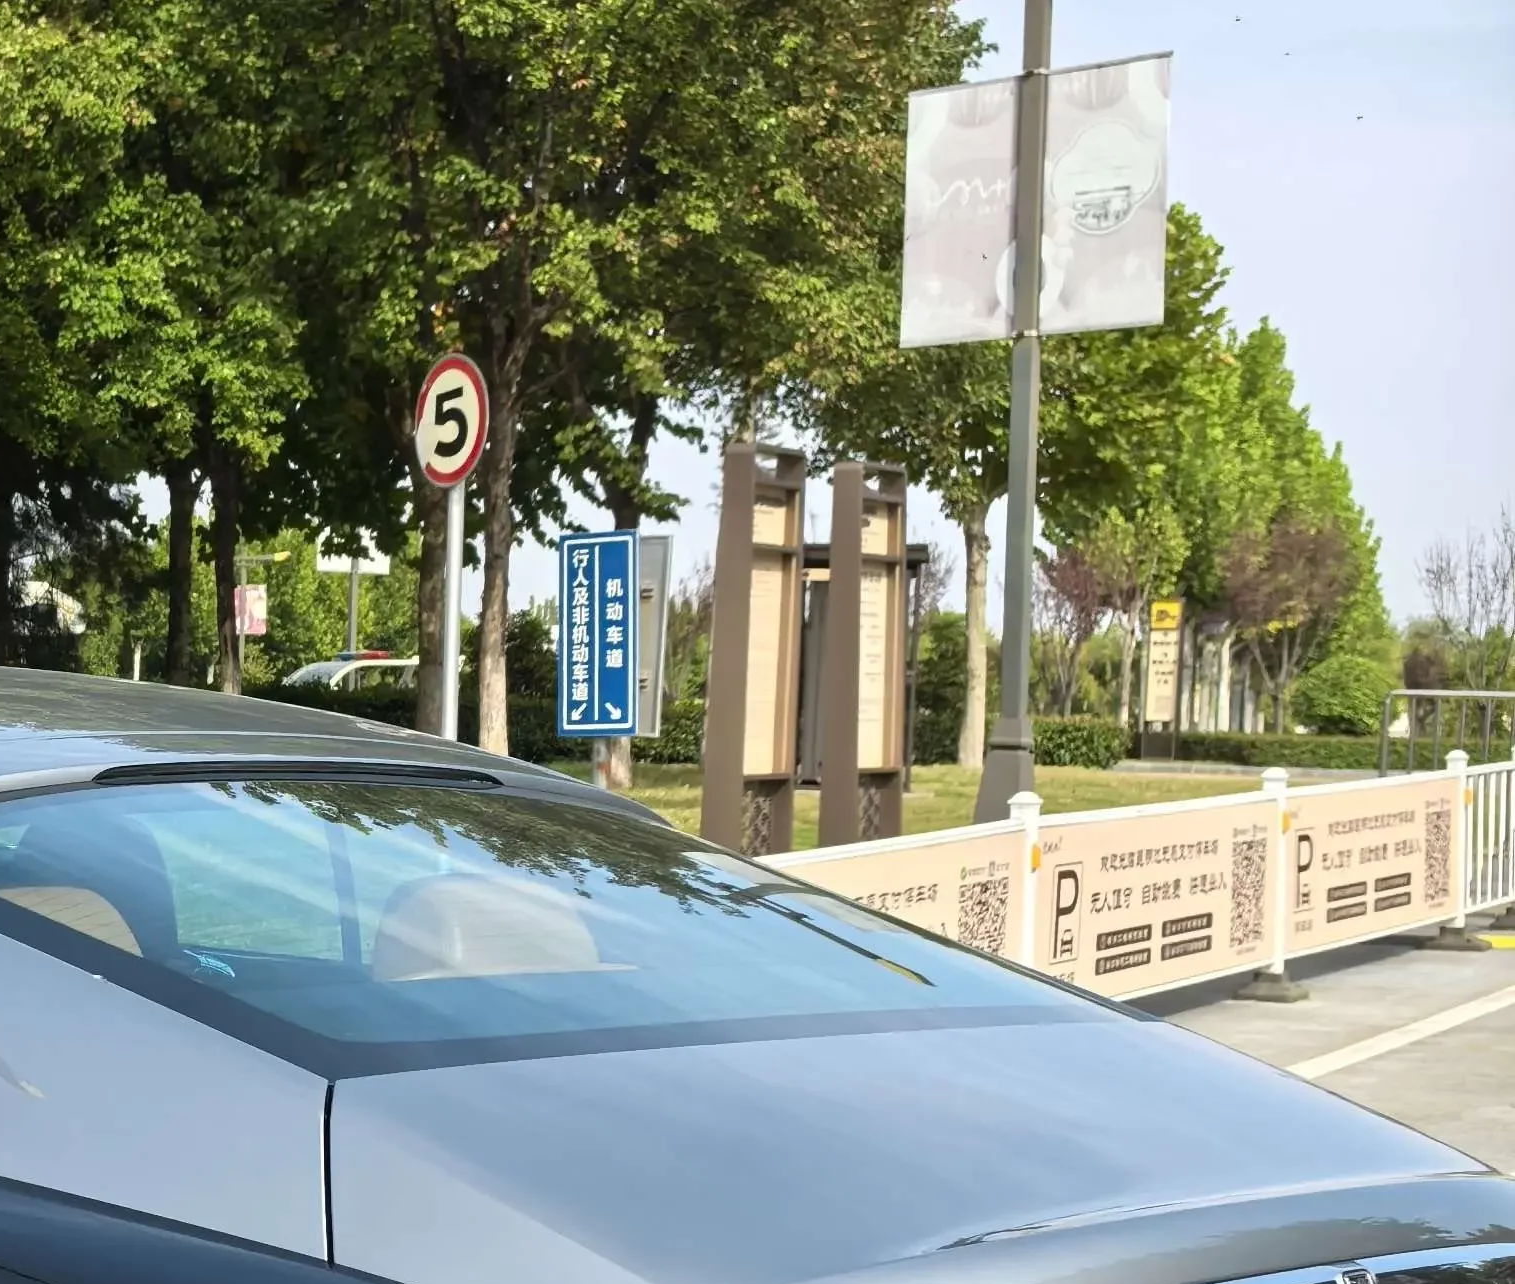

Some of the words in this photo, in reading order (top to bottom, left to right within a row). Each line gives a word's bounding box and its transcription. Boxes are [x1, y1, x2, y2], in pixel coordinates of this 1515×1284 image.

[433, 386, 468, 457] 5
[572, 548, 590, 701] 行人及非机动车道
[605, 578, 624, 669] 机动车道
[1053, 869, 1079, 959] P
